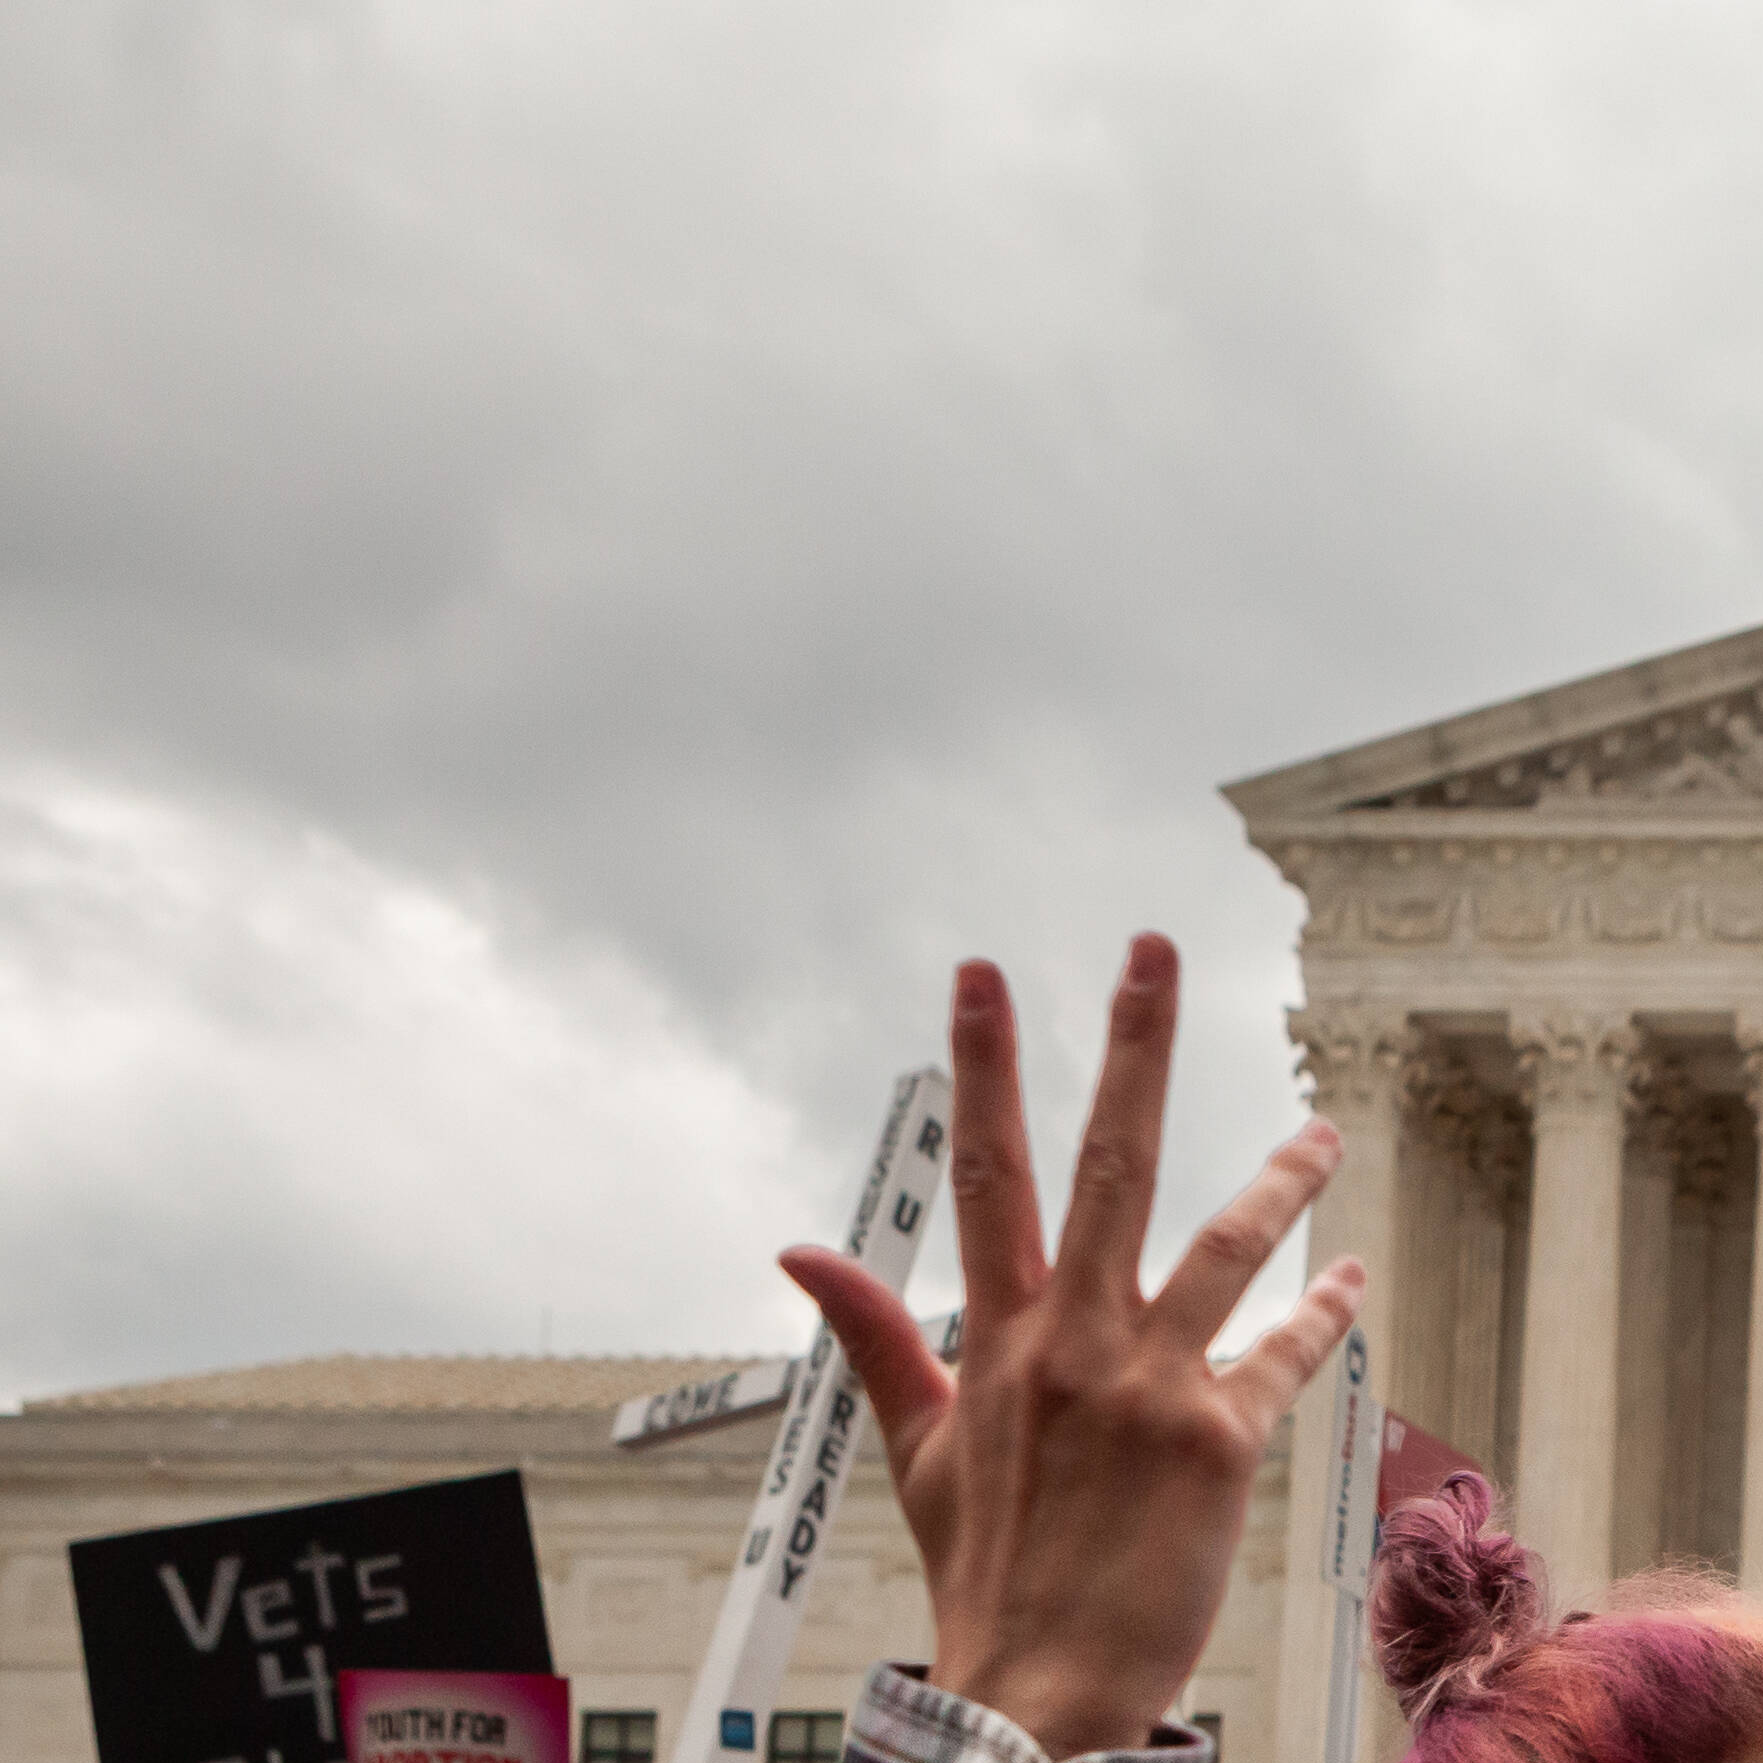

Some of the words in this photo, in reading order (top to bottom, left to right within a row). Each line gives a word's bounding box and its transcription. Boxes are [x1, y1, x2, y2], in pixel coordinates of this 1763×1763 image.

[779, 1385, 857, 1600] READY
[156, 1541, 411, 1652] Vets
[256, 1643, 337, 1743] 4
[452, 1707, 507, 1746] FOR
